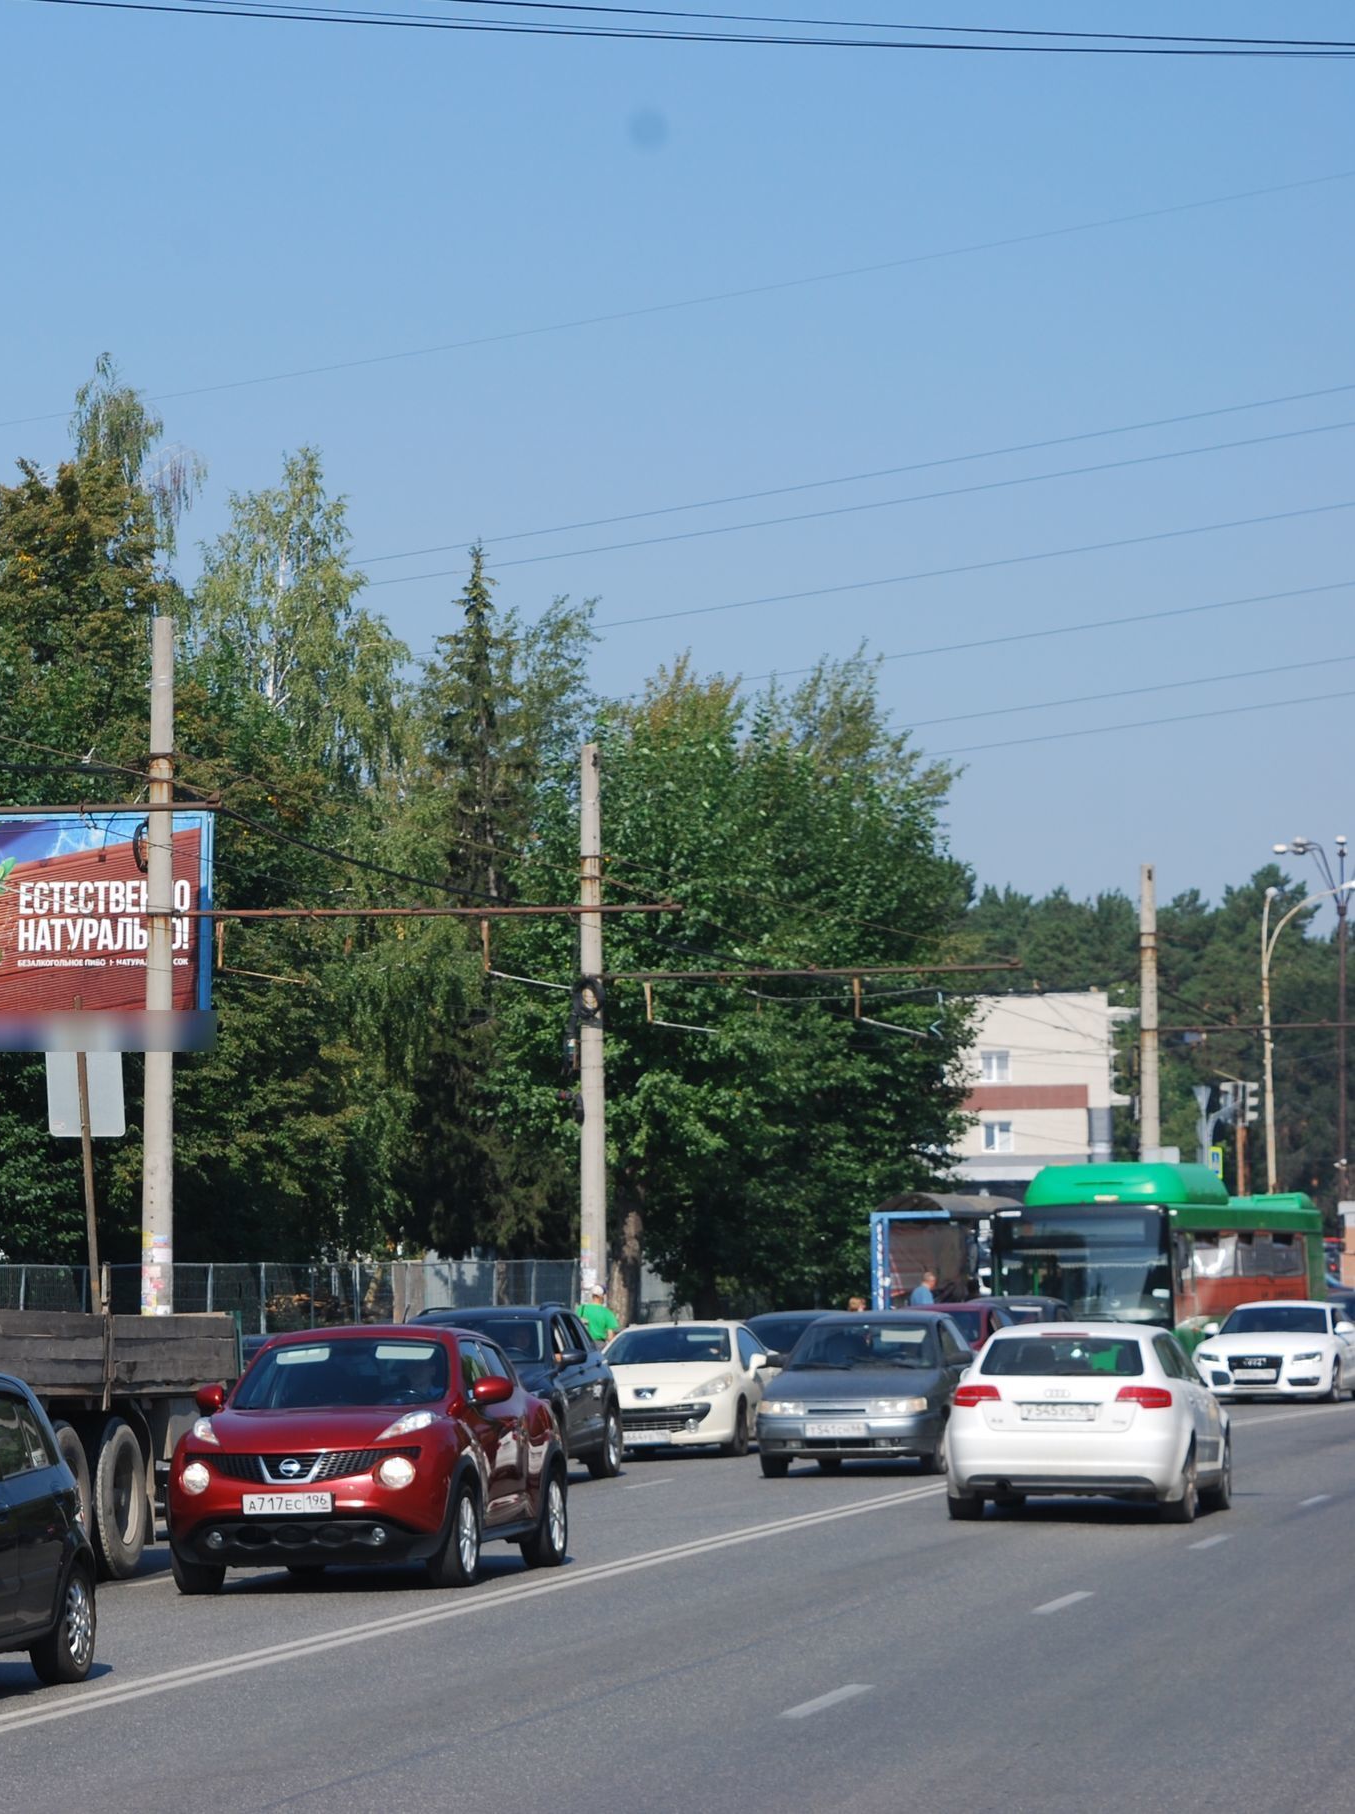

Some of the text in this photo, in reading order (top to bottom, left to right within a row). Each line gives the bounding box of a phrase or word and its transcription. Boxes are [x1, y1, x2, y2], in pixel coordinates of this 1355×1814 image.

[19, 880, 191, 914] ЕСТЕСТВЕО
[18, 917, 189, 951] НАТУРАЛЬО!
[17, 959, 83, 967] БЕЗАЛКОГОЛЬНОЕ
[85, 959, 105, 967] ПИВО
[173, 958, 188, 966] СОК
[248, 1494, 327, 1511] А717ЕС 196
